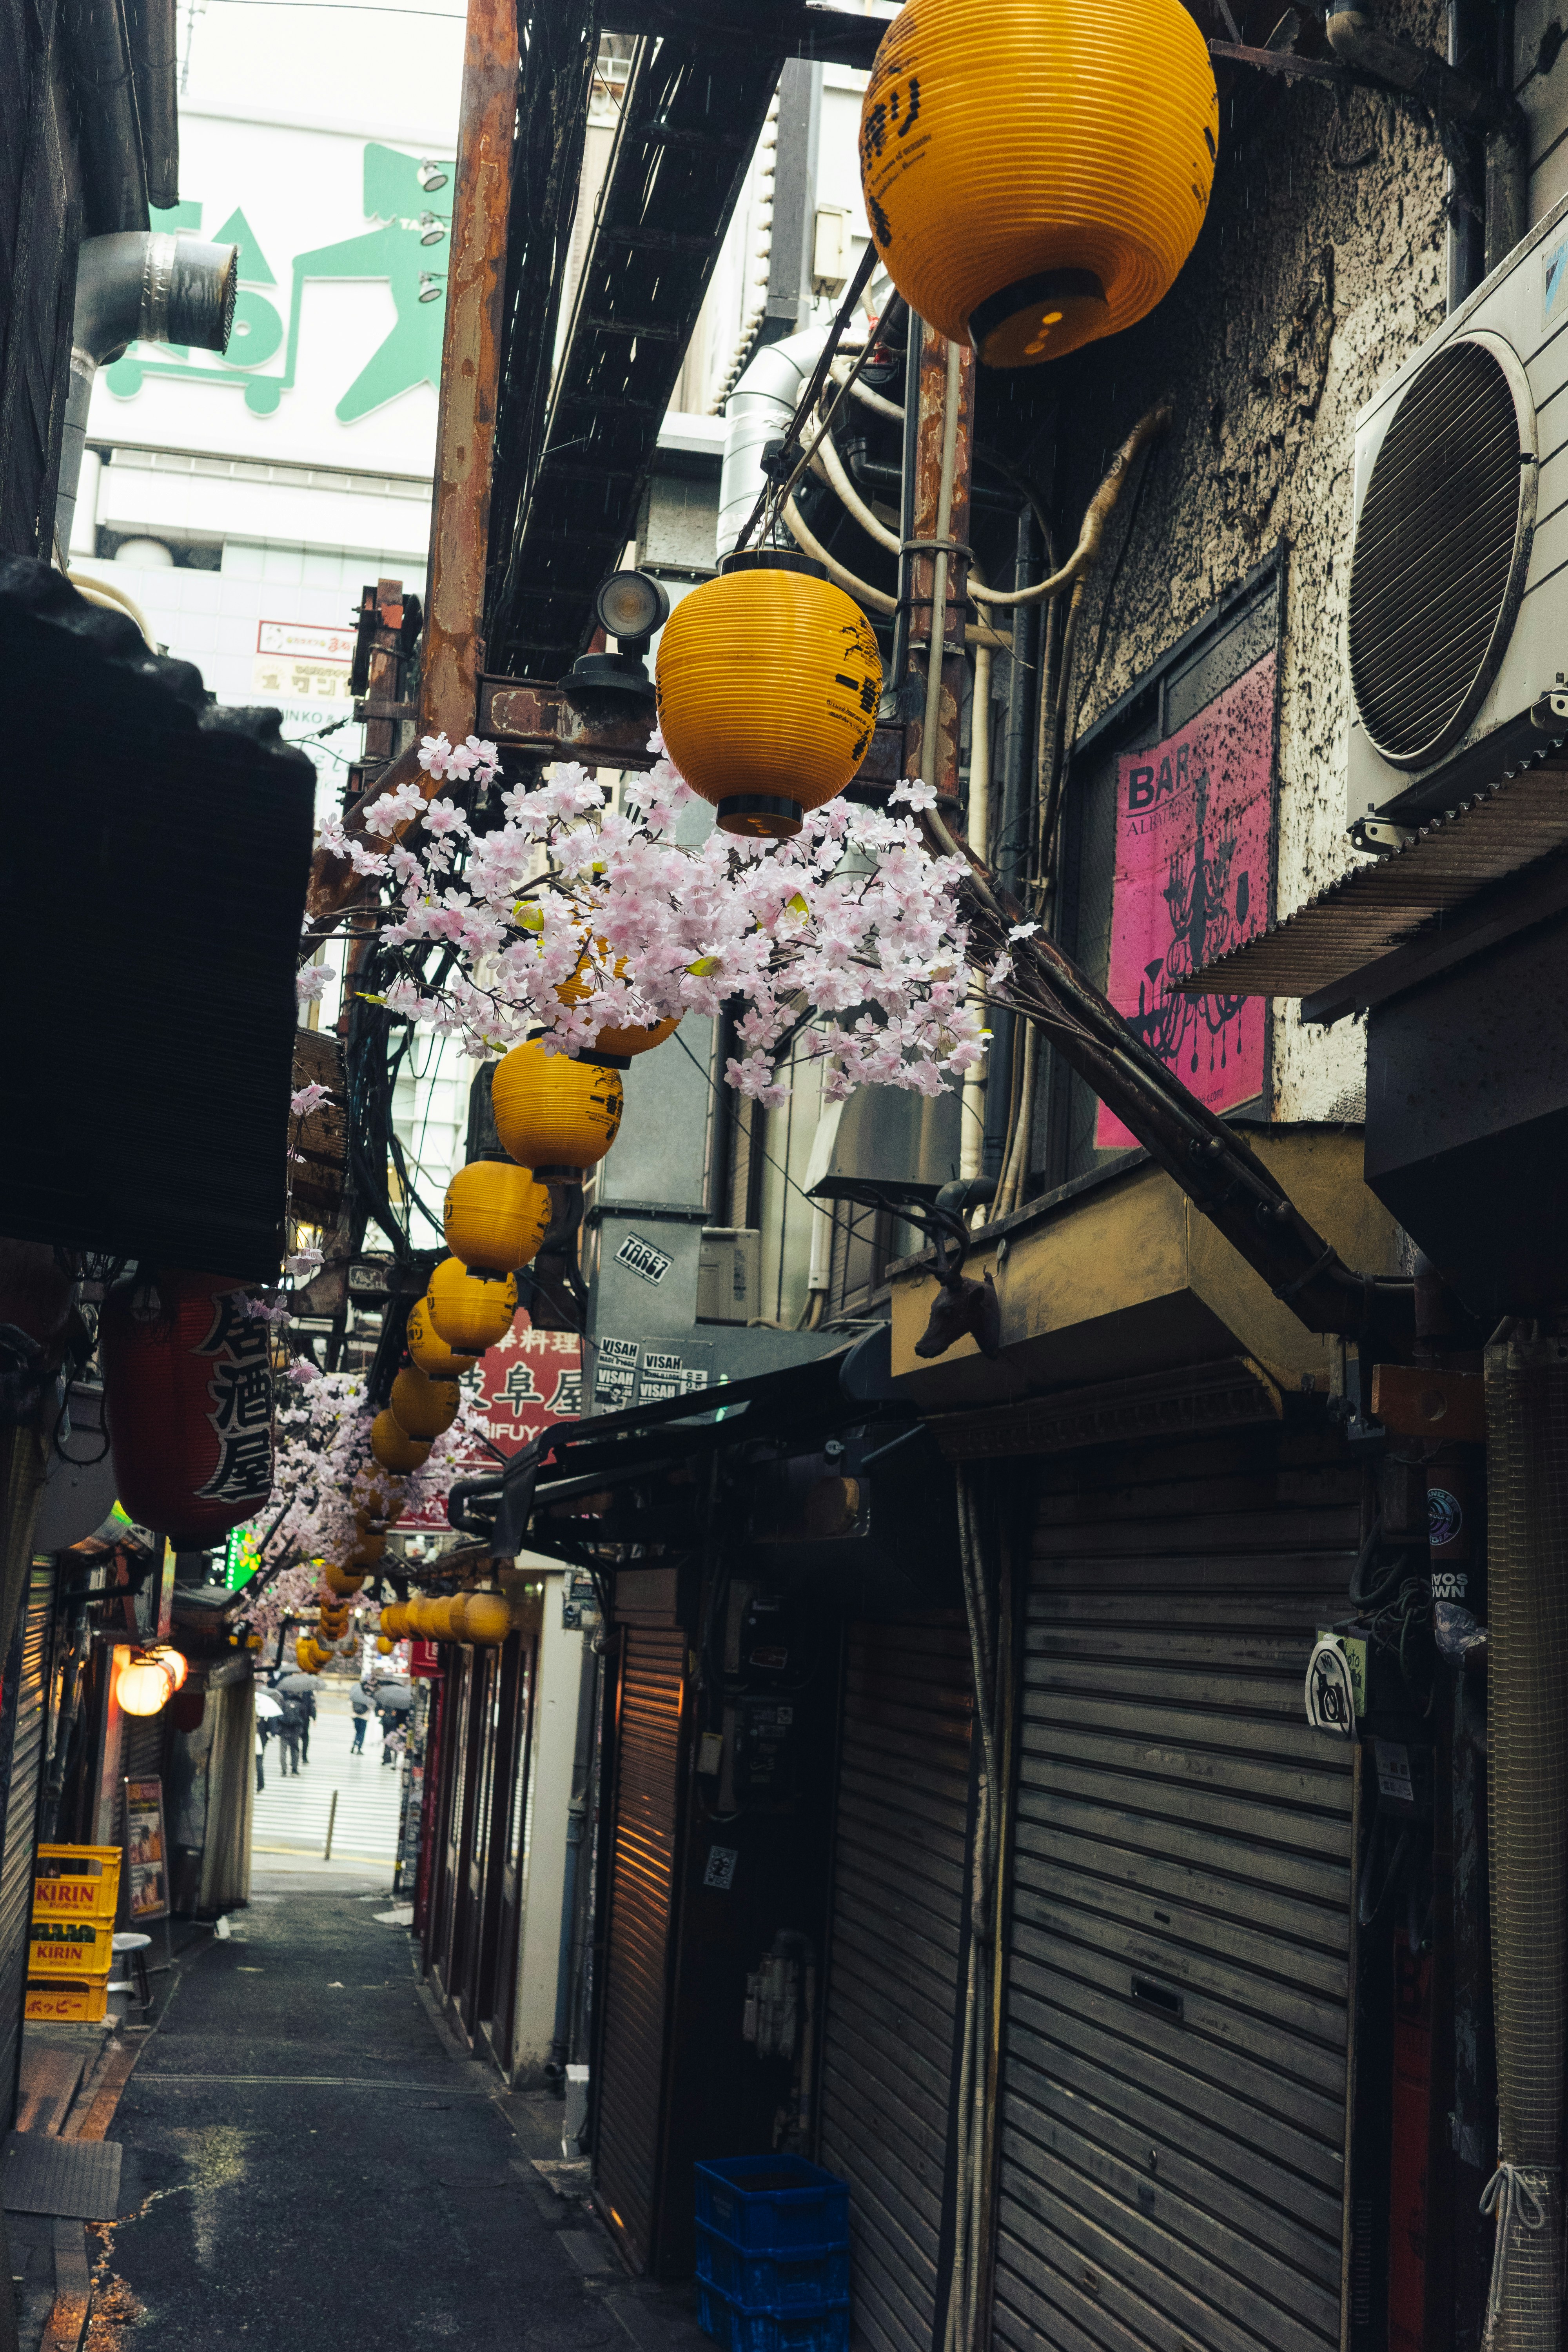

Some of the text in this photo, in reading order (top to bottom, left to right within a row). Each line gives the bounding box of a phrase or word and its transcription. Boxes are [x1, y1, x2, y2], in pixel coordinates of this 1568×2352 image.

[1129, 743, 1190, 810] BAR
[603, 1339, 637, 1357] VISAH
[646, 1355, 681, 1370] VISAH
[598, 1369, 634, 1386] VISAH
[640, 1383, 675, 1398] VISAH
[485, 1423, 549, 1442] IFUY
[1320, 1653, 1333, 1669] NO
[36, 1885, 94, 1902] KIRIN
[37, 1945, 82, 1959] KIRIN
